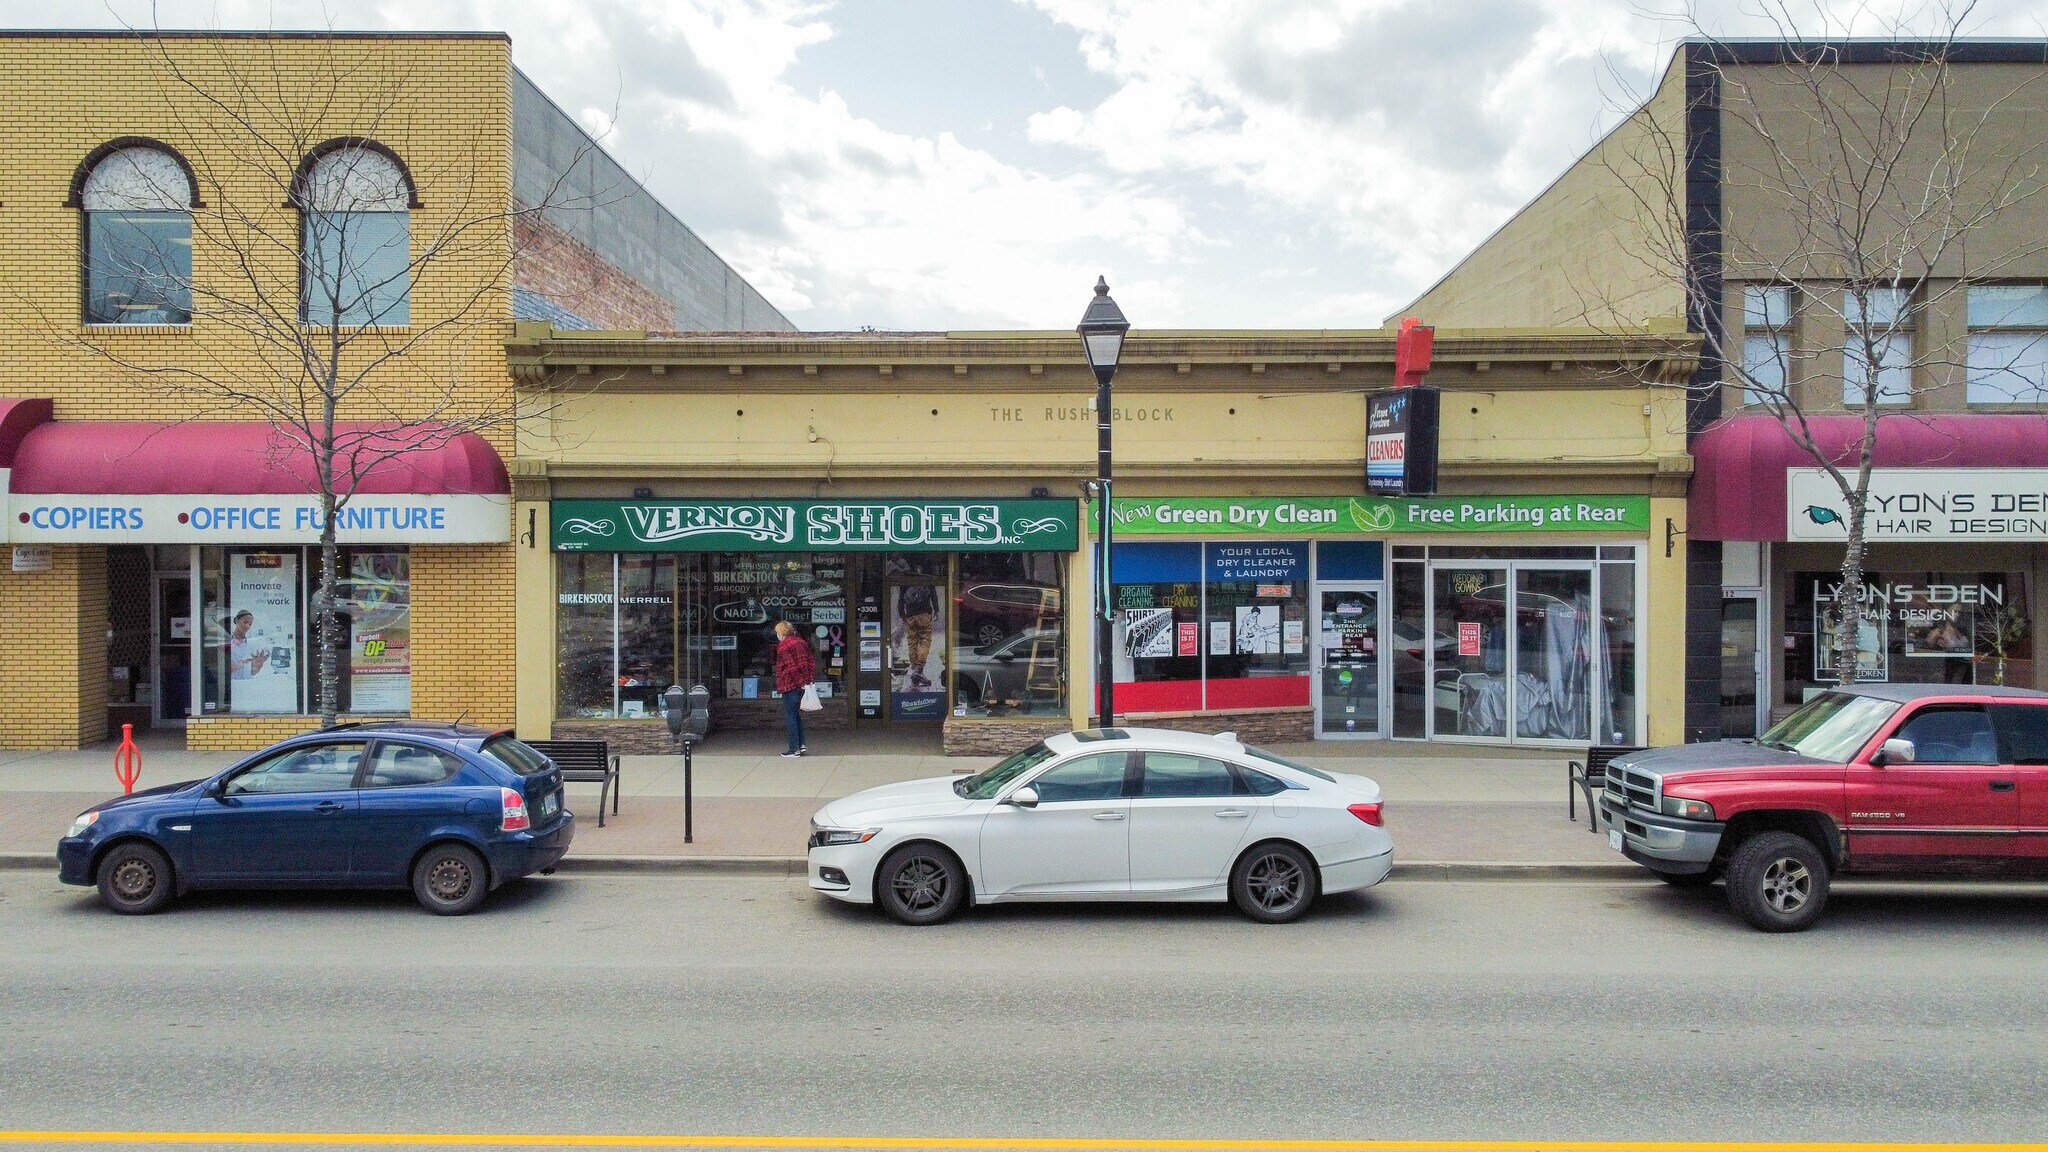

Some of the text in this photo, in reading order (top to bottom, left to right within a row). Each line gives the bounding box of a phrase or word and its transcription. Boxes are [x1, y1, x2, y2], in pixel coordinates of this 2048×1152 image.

[991, 408, 1174, 421] THE RUSH BLOCK
[1369, 439, 1404, 461] CLEANERS
[1990, 491, 2048, 513] DE
[32, 507, 445, 530] COPIERS OFFICE FURNITURE
[1095, 502, 1338, 527] New Green Dry Clean
[1408, 503, 1626, 527] Free Parking at Rear
[620, 505, 1025, 545] VERNON SHOES INC.
[1876, 518, 2047, 534] HAIR DESIGN
[1220, 548, 1293, 556] YOUR LOCAL
[1216, 558, 1297, 567] DRY CLEANER
[713, 571, 779, 584] BIRKENSTOCK
[1224, 569, 1290, 578] & LAUNDRY
[1452, 574, 1484, 583] WEDDING
[1120, 587, 1154, 597] ORGANIC
[1173, 584, 1189, 595] DRY
[1258, 586, 1289, 595] OPEN
[1455, 583, 1480, 592] GOWNS
[559, 593, 613, 604] BIRKENSTOCK
[620, 596, 673, 604] MERRELL
[1927, 583, 2003, 605] DEN
[762, 596, 798, 606] ecco
[1118, 597, 1155, 607] CLEANING
[1162, 596, 1199, 608] CLEANING
[724, 608, 756, 618] NAOT
[785, 609, 843, 621] Josef Seibel
[1126, 609, 1156, 627] SHIRTS
[1858, 608, 1956, 621] HAIR DESIGN
[365, 640, 386, 656] OP
